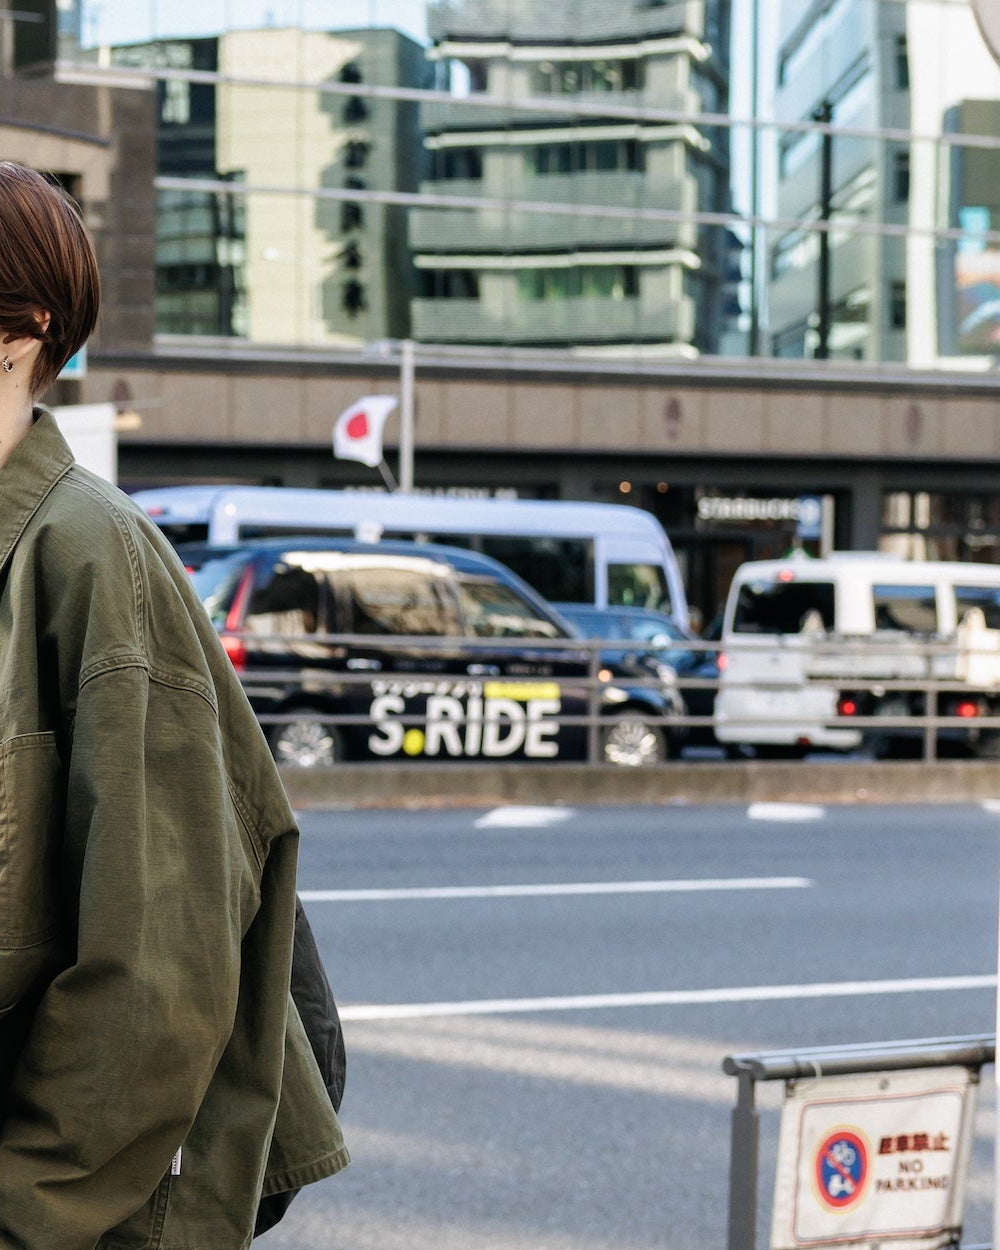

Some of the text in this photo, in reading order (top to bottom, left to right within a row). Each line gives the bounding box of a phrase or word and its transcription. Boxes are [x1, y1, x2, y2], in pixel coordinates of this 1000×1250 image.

[369, 695, 561, 757] S.RIDE
[899, 1159, 924, 1172] NO
[875, 1175, 949, 1192] PARKING
